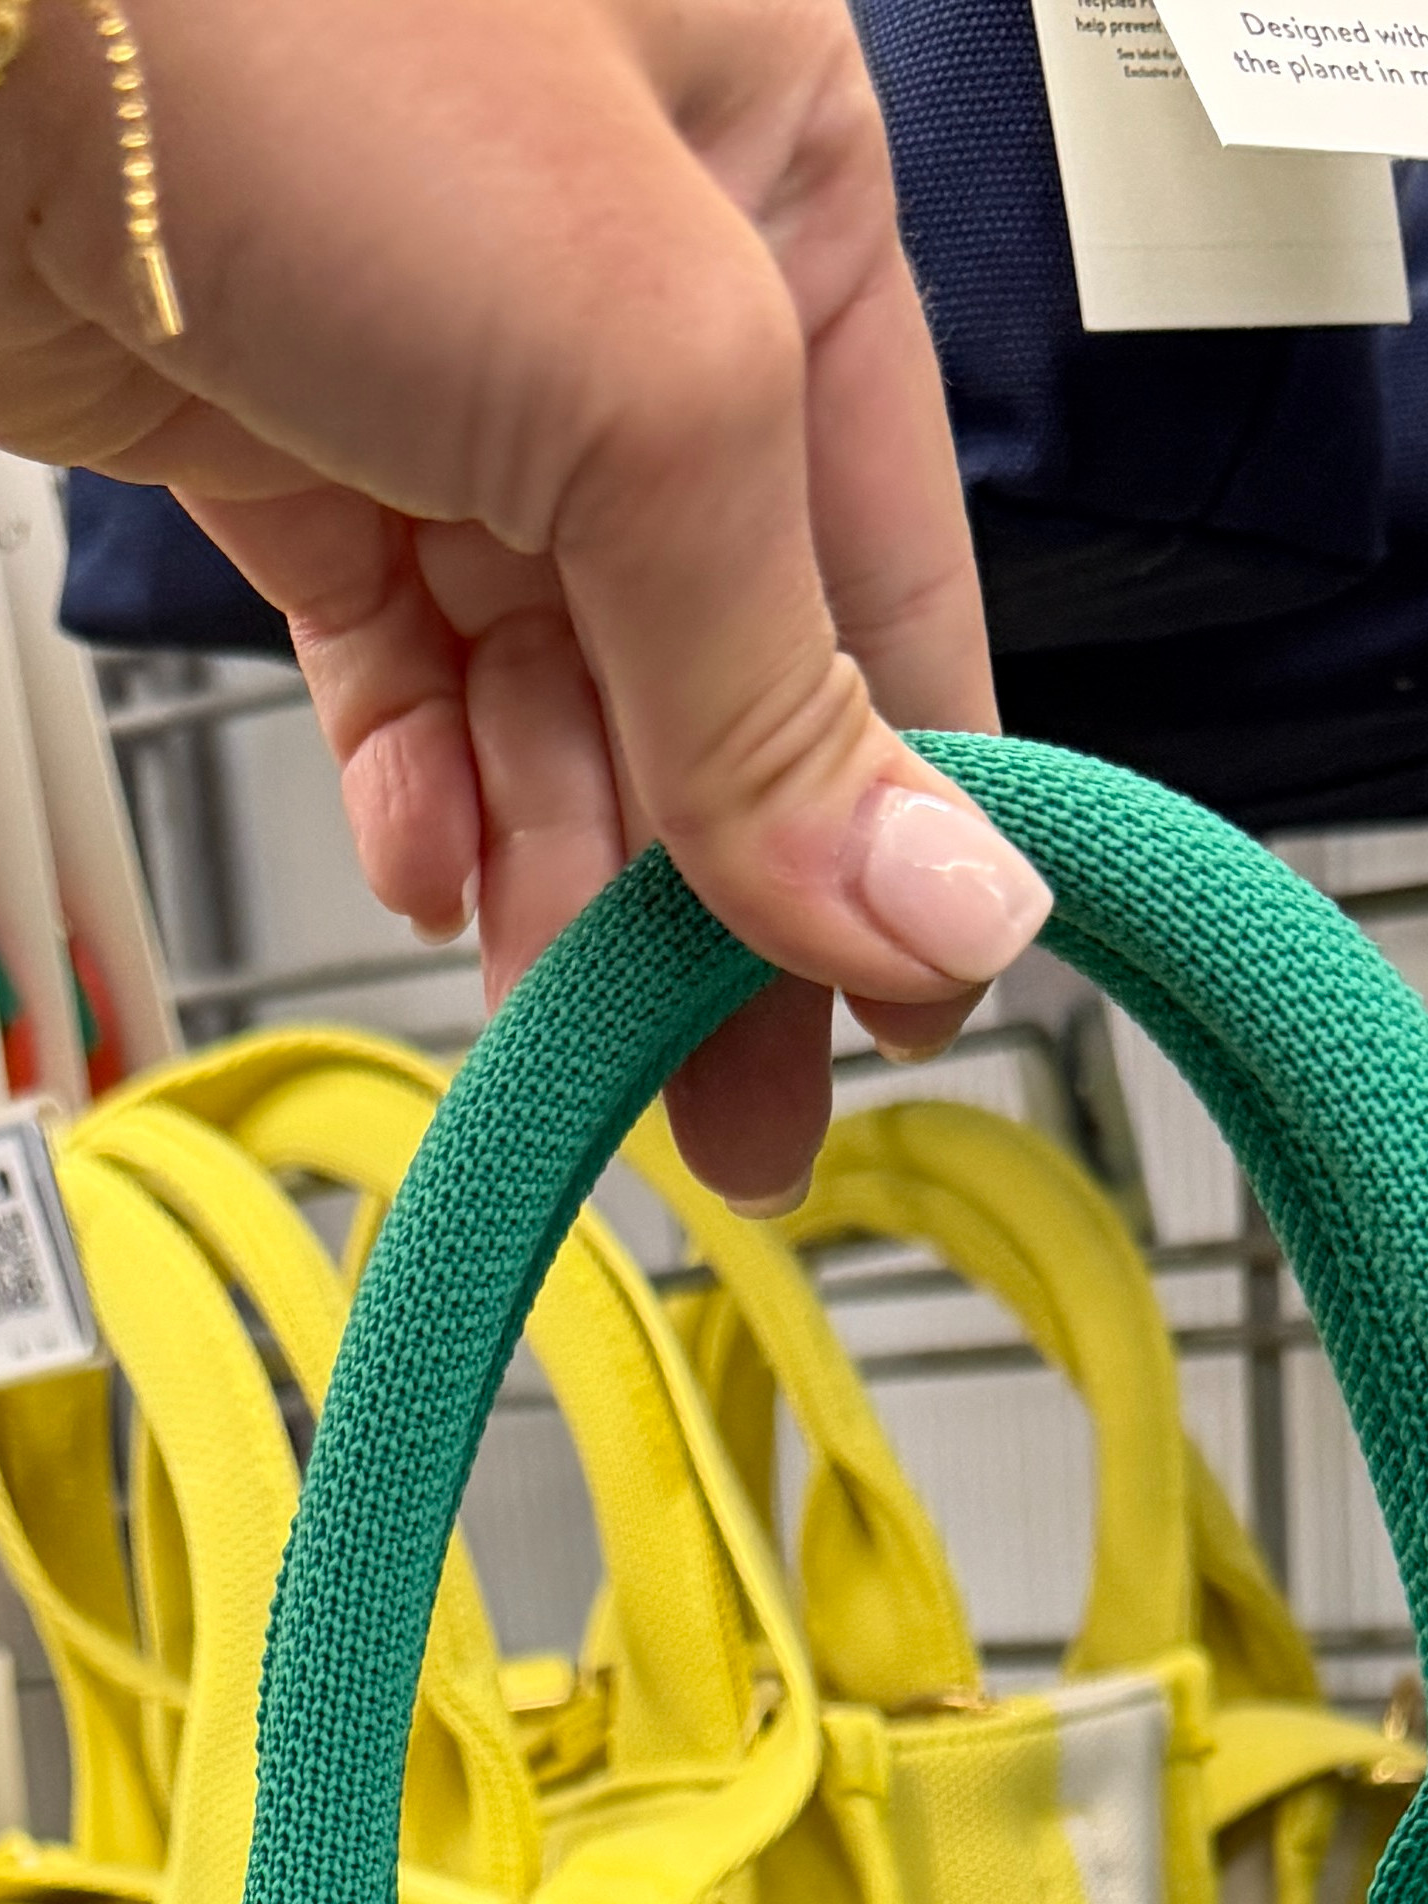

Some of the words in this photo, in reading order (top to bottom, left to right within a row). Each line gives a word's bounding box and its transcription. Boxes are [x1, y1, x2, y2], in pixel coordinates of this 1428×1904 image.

[1075, 16, 1107, 38] help
[1110, 19, 1163, 38] prevent
[1240, 12, 1371, 47] Designed
[1233, 50, 1281, 75] the
[1287, 54, 1374, 84] planet
[1375, 59, 1405, 84] in
